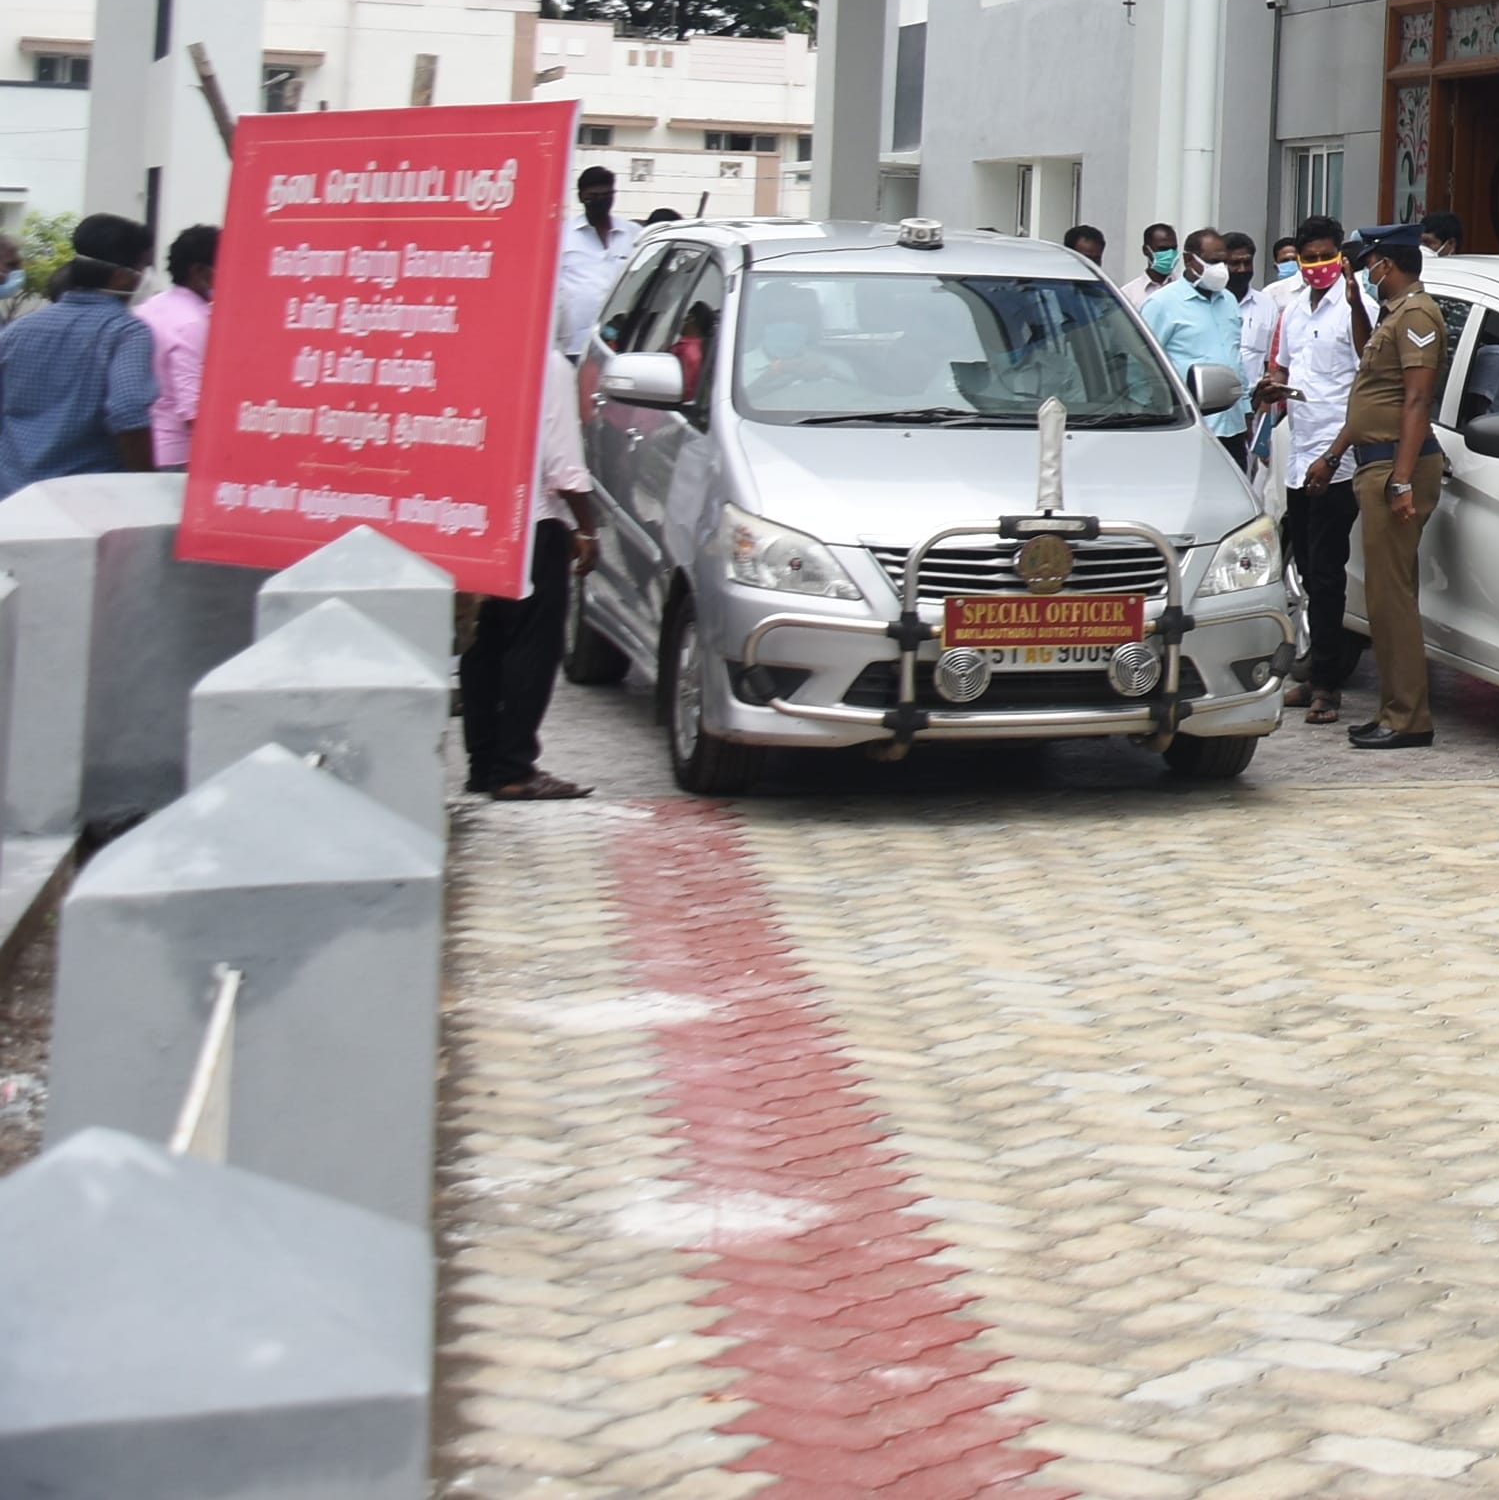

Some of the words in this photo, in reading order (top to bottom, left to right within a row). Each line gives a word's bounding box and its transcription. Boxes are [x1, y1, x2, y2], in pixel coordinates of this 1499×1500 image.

[961, 602, 1041, 625] SPECIAL
[1045, 601, 1125, 623] OFFICER
[1081, 625, 1133, 638] FORMATION
